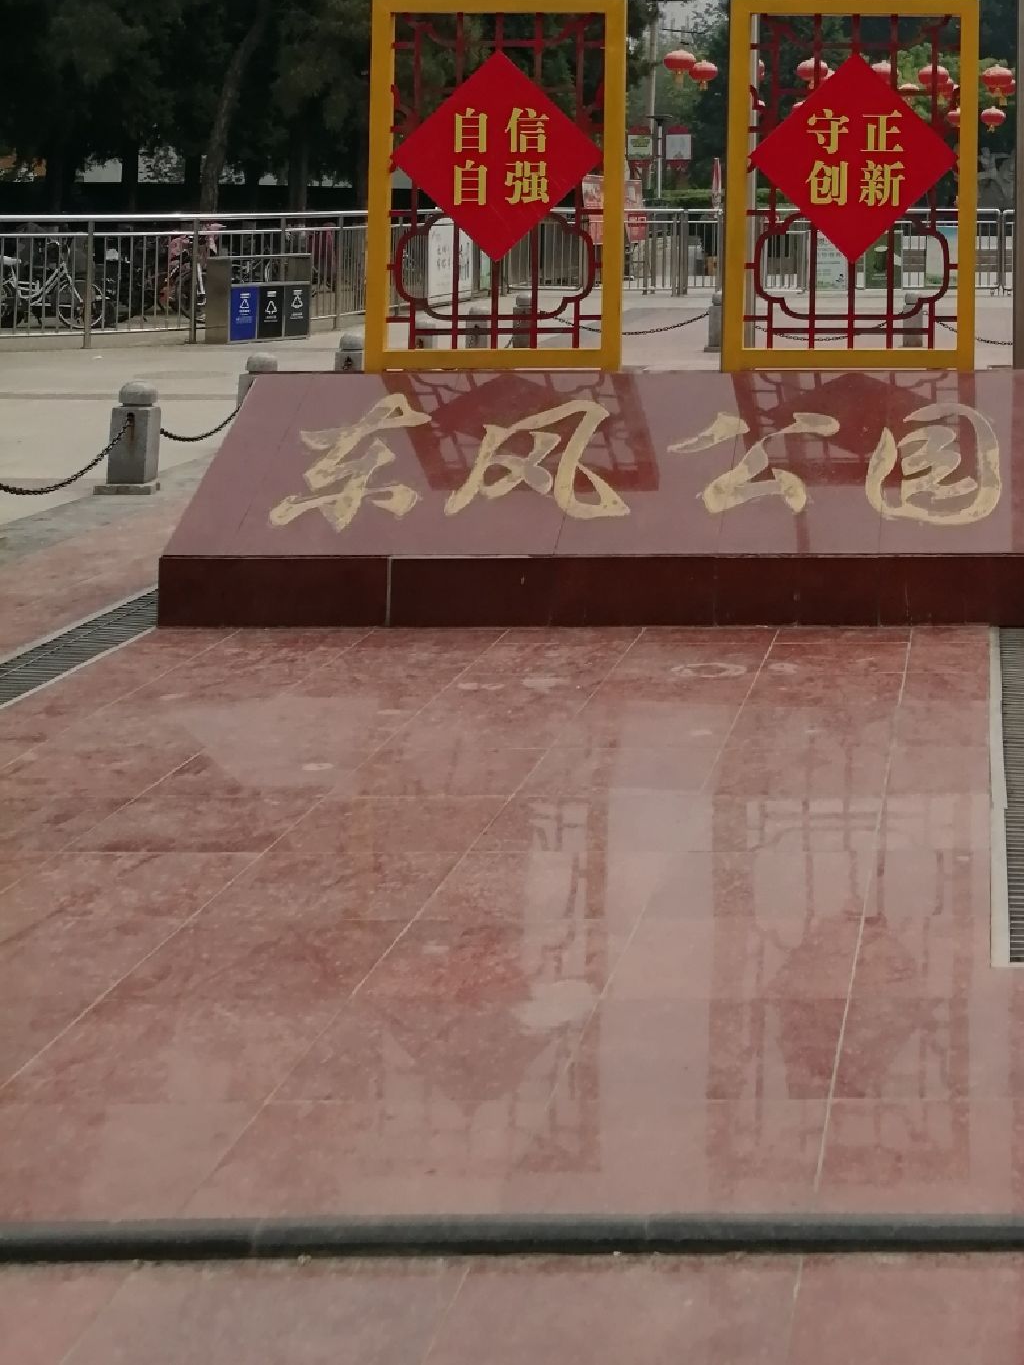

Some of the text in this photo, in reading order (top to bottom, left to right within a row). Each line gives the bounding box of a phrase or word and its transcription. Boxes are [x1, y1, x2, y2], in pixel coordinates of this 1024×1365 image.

[454, 107, 550, 153] 自信
[806, 108, 904, 155] 守正
[453, 159, 550, 206] 自强
[805, 159, 906, 207] 创新
[269, 393, 1002, 532] 东风公园
